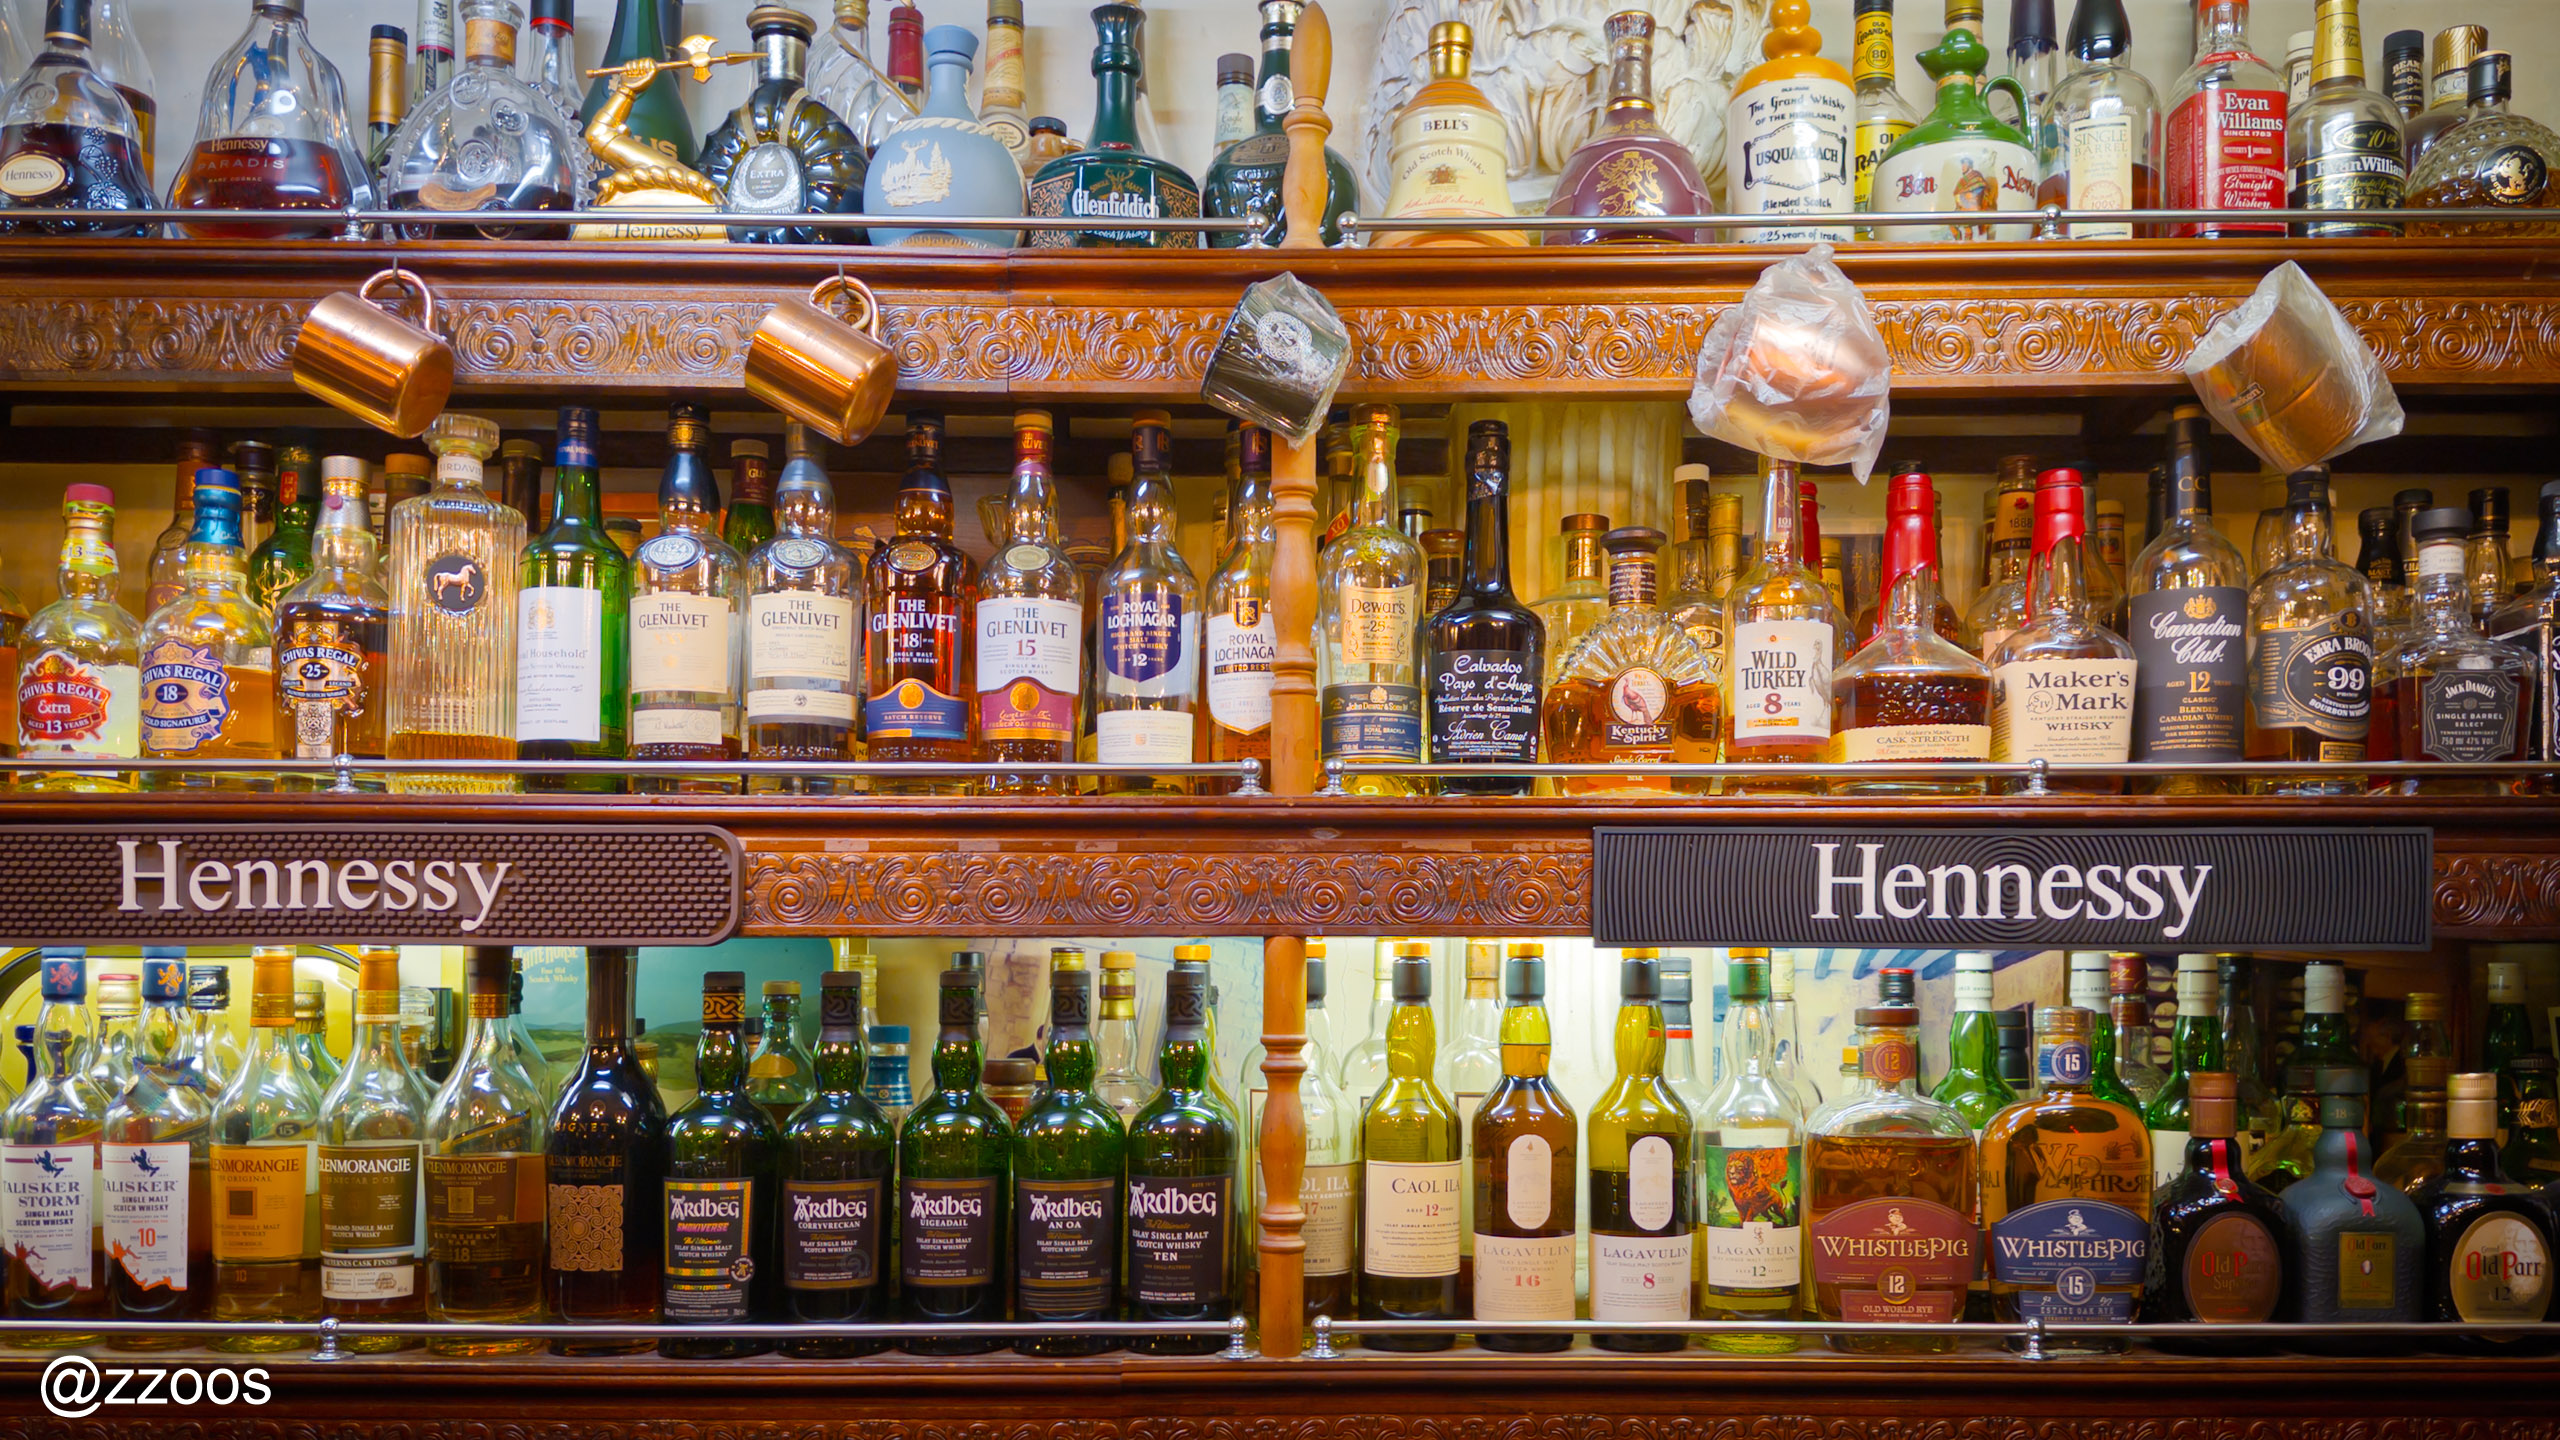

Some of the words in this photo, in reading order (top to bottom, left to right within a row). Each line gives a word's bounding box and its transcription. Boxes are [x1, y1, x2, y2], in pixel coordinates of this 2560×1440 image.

[1872, 50, 1887, 59] 80
[2293, 70, 2309, 86] JIM
[1748, 100, 1765, 118] The
[1771, 96, 1804, 112] Grand
[1810, 95, 1845, 113] Whisky
[2225, 93, 2269, 110] Evan
[1221, 113, 1243, 124] Eagle
[1423, 118, 1469, 132] BELL'S
[2215, 112, 2283, 131] Williams
[2074, 129, 2127, 146] SINGLE
[212, 139, 269, 151] Hennessy
[2074, 143, 2128, 157] BARREL
[198, 158, 284, 170] PARADIS
[1402, 161, 1417, 180] Old
[1418, 147, 1453, 164] Scotch
[1456, 148, 1487, 175] Whisky
[6, 169, 55, 182] Hennessy
[750, 169, 784, 179] EXTRA
[2224, 176, 2274, 191] Straight
[1073, 188, 1160, 218] Glenfiddich
[1762, 197, 1799, 211] Blended
[1803, 197, 1832, 208] Scotch
[614, 224, 706, 241] Hennessy
[1782, 229, 1806, 241] years
[1808, 229, 1816, 240] of
[660, 603, 680, 611] THE
[789, 600, 812, 610] THE
[899, 599, 925, 611] THE
[1122, 600, 1158, 613] ROYAL
[1014, 608, 1039, 618] THE
[639, 614, 708, 628] GLENLIVET
[762, 612, 840, 629] GLENLIVET
[873, 613, 956, 632] GLENLIVET
[1108, 614, 1175, 628] LOCHNAGAR
[1370, 620, 1385, 632] 25
[2150, 611, 2242, 639] Canadian
[987, 622, 1068, 638] GLENLIVET
[902, 633, 919, 648] 18
[1229, 634, 1266, 645] ROYAL
[1016, 639, 1036, 656] 15
[281, 648, 314, 664] CHIVAS
[317, 648, 356, 666] REGAL
[1132, 654, 1148, 666] 12
[1752, 650, 1797, 669] WILD
[306, 664, 321, 678] 25
[1454, 655, 1522, 674] Calvados
[141, 666, 171, 686] CHIVAS
[174, 665, 221, 687] REGAL
[1742, 668, 1806, 690] TURKEY
[2026, 671, 2129, 689] Maker's
[2327, 667, 2366, 690] 99
[1439, 674, 1476, 692] Pays
[1485, 674, 1533, 693] d'Auge
[2444, 680, 2465, 699] JACK
[2465, 679, 2497, 699] DANIEL'S
[19, 682, 54, 702] CHIVAS
[57, 682, 103, 702] REGAL
[162, 686, 178, 701] 18
[38, 700, 71, 714] Extra
[1438, 703, 1472, 714] Réserve
[1474, 704, 1484, 712] de
[1486, 703, 1532, 714] Semainville
[1764, 693, 1783, 714] 8
[2055, 693, 2127, 710] Mark
[2309, 699, 2348, 717] BOURBON
[2179, 706, 2218, 714] BLENDED
[28, 720, 45, 729] AGED
[46, 720, 62, 733] 13
[64, 718, 90, 729] YEARS
[2159, 715, 2204, 724] CANADIAN
[2206, 714, 2234, 722] WHISKY
[1442, 720, 1485, 741] Adrien
[1612, 726, 1667, 736] Kentucky
[2046, 722, 2113, 731] WHISKY
[1624, 734, 1657, 744] Spirit
[1877, 735, 1906, 744] CASK
[117, 841, 512, 932] Hennessy
[1811, 843, 2213, 938] Hennessy
[1885, 1053, 1900, 1069] 12
[2064, 1055, 2080, 1071] 15
[278, 1125, 295, 1135] 15
[1392, 1178, 1440, 1194] CAOL
[1445, 1179, 1460, 1192] ILA
[19, 1195, 80, 1207] STORM
[113, 1204, 137, 1212] SCOTCH
[138, 1204, 168, 1212] WHISKY
[25, 1210, 52, 1218] SINGLE
[44, 1218, 74, 1226] WHISKY
[677, 1222, 729, 1232] SMOKIVERSE
[798, 1221, 860, 1229] CORRYVRECKAN
[1049, 1221, 1064, 1229] AN
[1066, 1221, 1081, 1229] OA
[138, 1228, 156, 1248] 10
[1132, 1230, 1149, 1239] ISLAY
[1151, 1231, 1182, 1240] SINGLE
[1185, 1231, 1209, 1239] MALT
[1483, 1245, 1570, 1256] LAGAVULIN
[1603, 1247, 1688, 1259] LAGAVULIN
[1716, 1245, 1796, 1255] LAGAVULIN
[1817, 1236, 1969, 1259] WHISTLEPIG
[1997, 1236, 2145, 1259] WHISTLEPIG
[454, 1249, 470, 1262] 18
[1153, 1252, 1178, 1261] TEN
[2201, 1251, 2230, 1277] Old
[2466, 1251, 2499, 1279] Old
[2501, 1250, 2541, 1281] Parr
[1752, 1266, 1766, 1277] 12
[1514, 1275, 1540, 1287] 16
[1643, 1273, 1655, 1289] 8
[1889, 1275, 1905, 1293] 12
[2068, 1275, 2083, 1295] 15
[1862, 1305, 1884, 1314] OLD
[1886, 1305, 1914, 1314] WORLD
[1916, 1305, 1933, 1314] RYE
